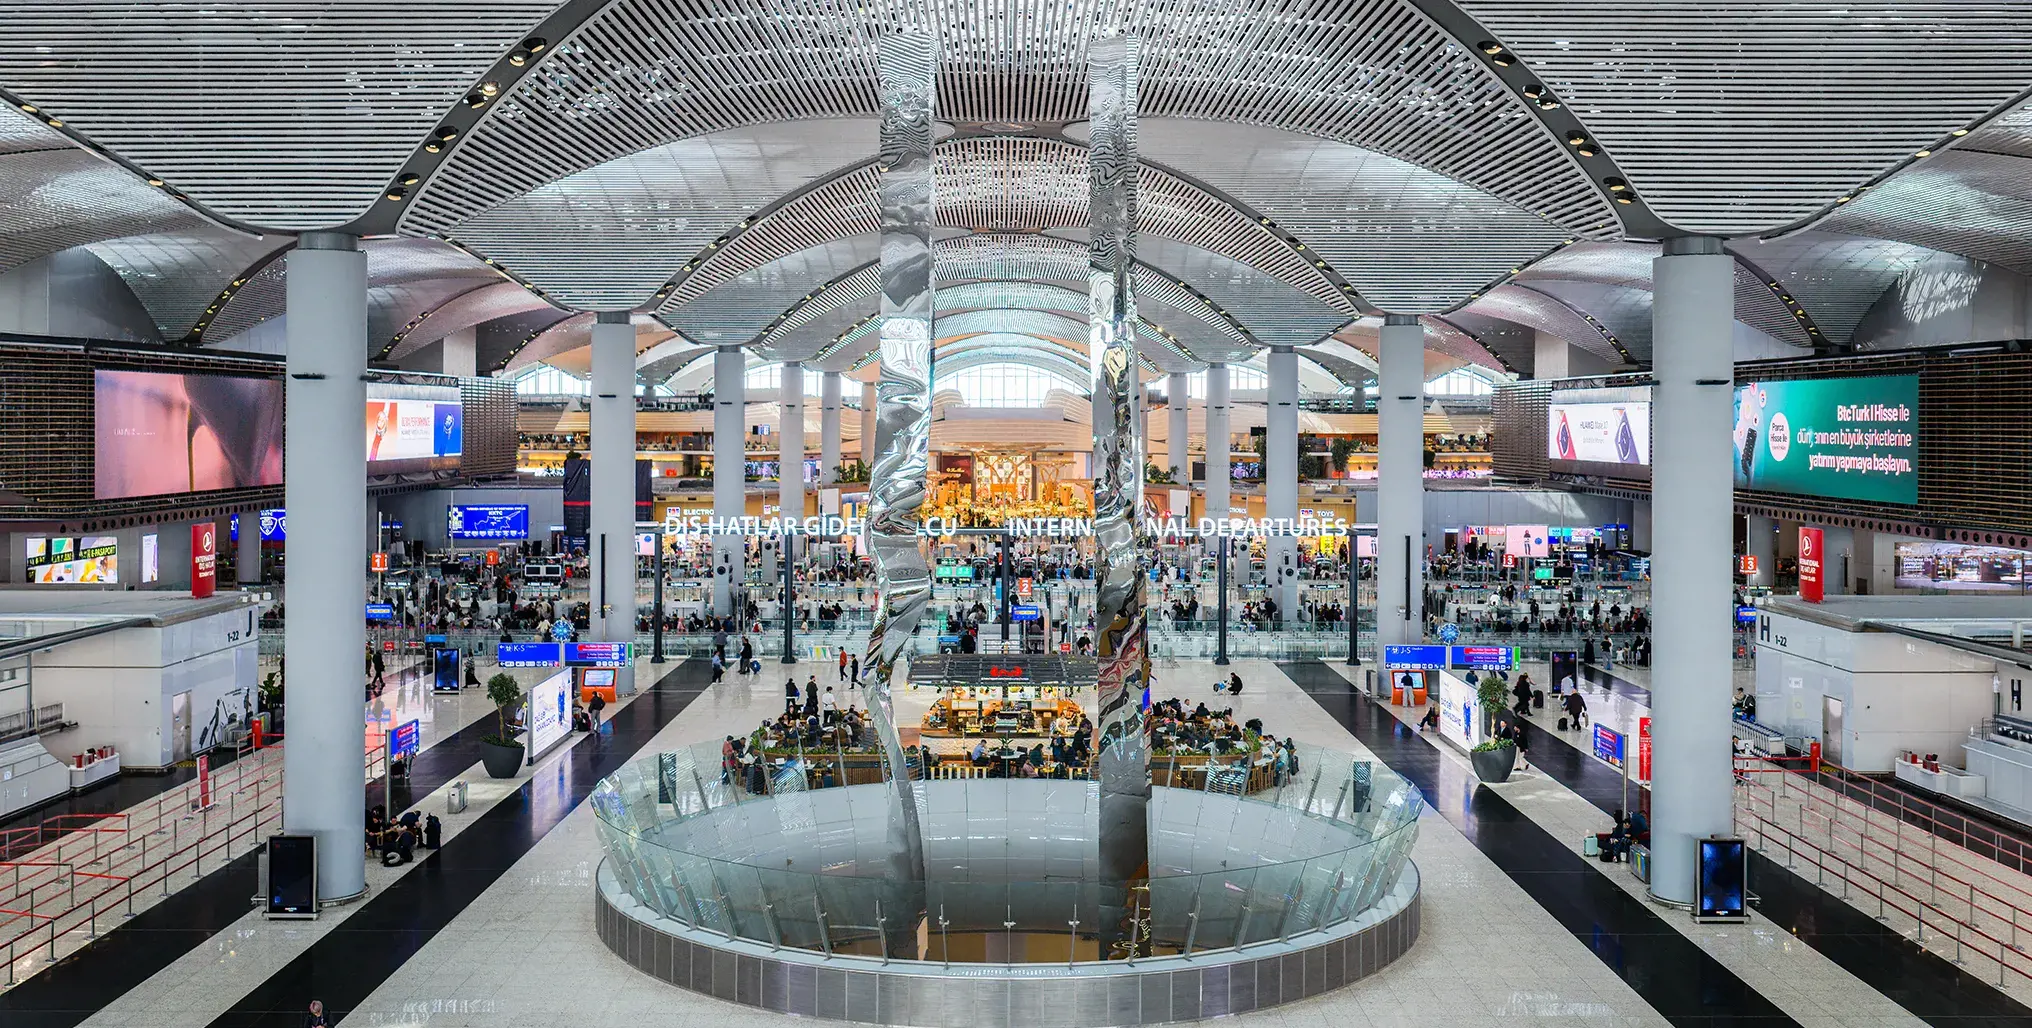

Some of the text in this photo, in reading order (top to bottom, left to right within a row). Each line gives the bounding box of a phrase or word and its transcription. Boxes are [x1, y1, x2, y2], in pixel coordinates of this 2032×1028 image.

[1837, 404, 1870, 421] BtcTurk
[1874, 404, 1898, 421] Hisse
[1899, 404, 1910, 421] ile
[1830, 432, 1840, 444] en
[1840, 428, 1864, 449] büyük
[1864, 428, 1912, 449] şirketlerine
[1809, 452, 1912, 476] yatırım yapmaya başlayın.
[709, 516, 797, 535] HATLAR
[916, 516, 957, 536] LCU
[1200, 517, 1347, 537] DEPARTURES
[375, 557, 380, 567] 1
[1747, 560, 1754, 570] 3
[1022, 583, 1029, 592] 2
[246, 610, 252, 637] J
[1760, 614, 1770, 642] H
[227, 631, 239, 642] 1-22
[1775, 634, 1787, 647] 1-22
[2011, 678, 2021, 711] H
